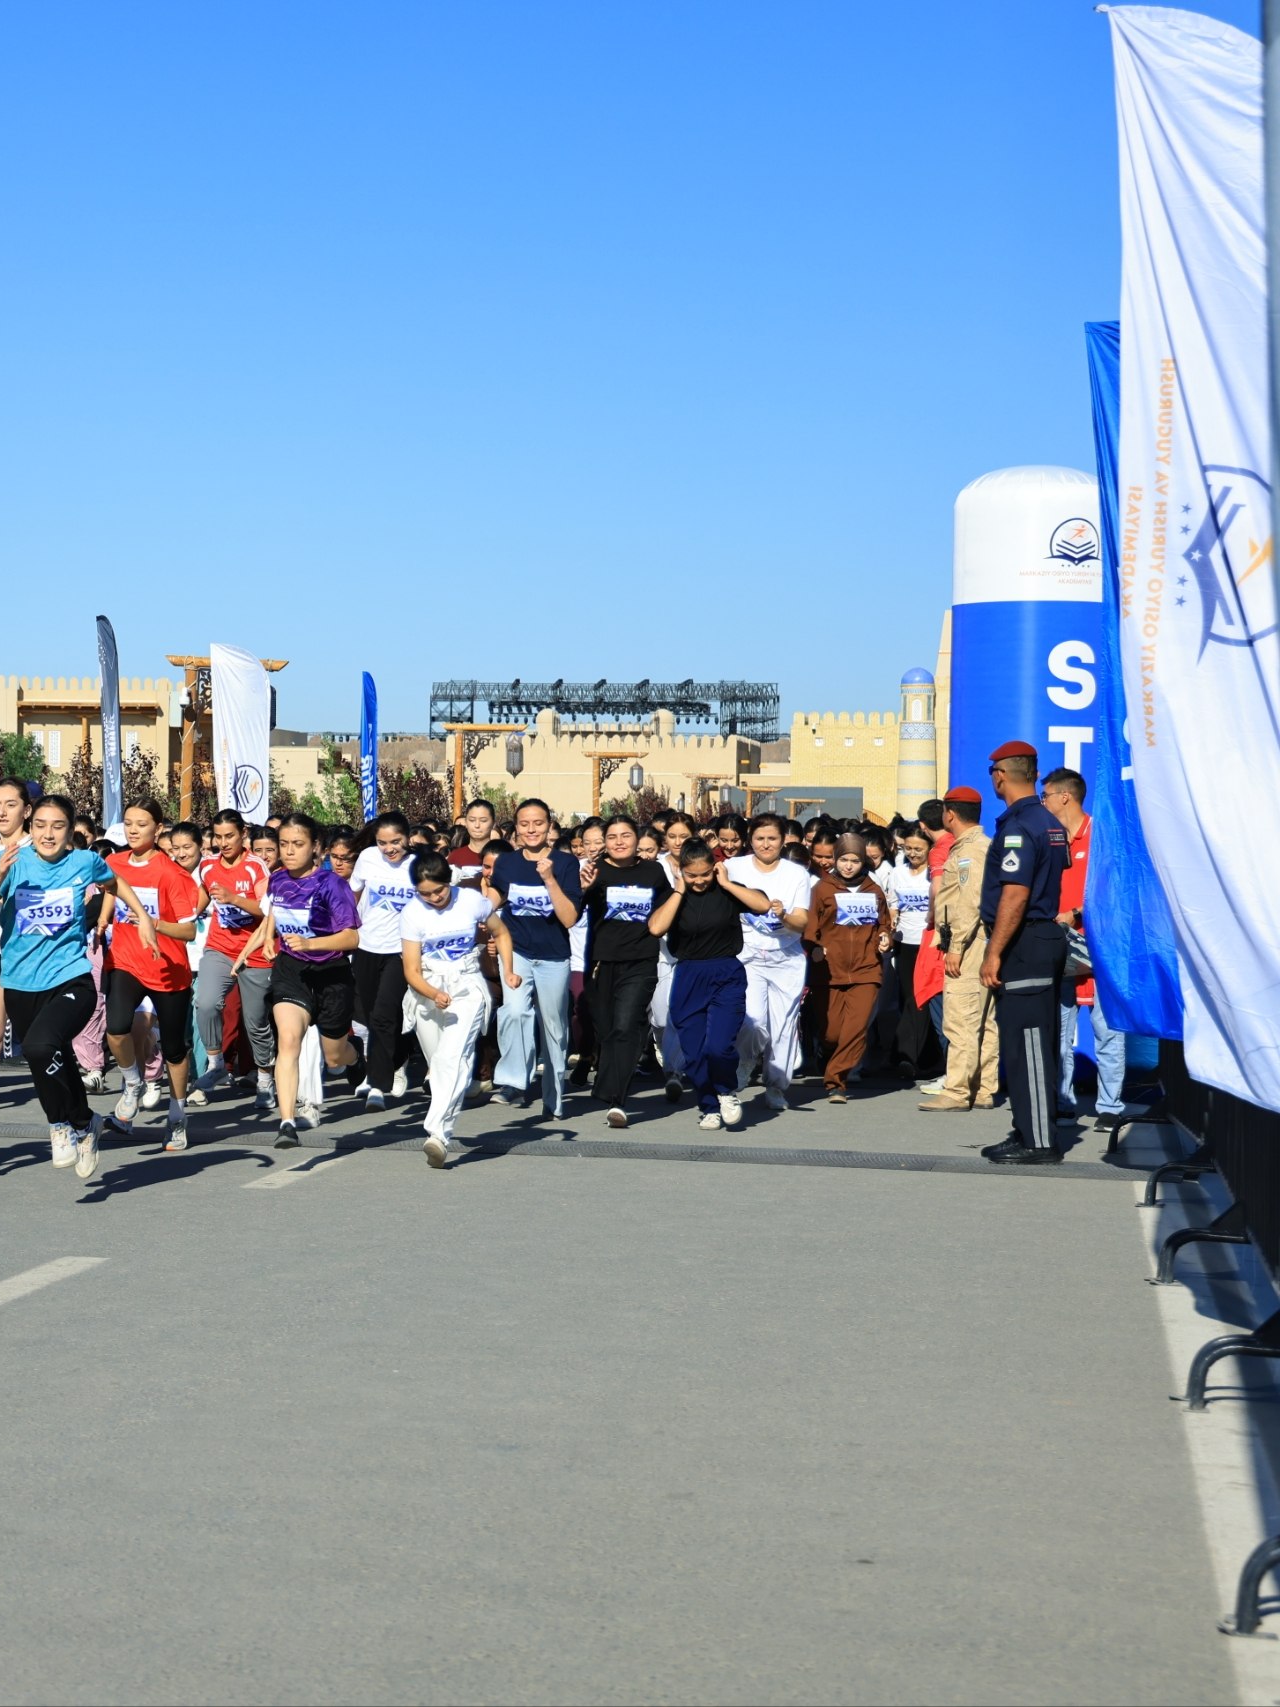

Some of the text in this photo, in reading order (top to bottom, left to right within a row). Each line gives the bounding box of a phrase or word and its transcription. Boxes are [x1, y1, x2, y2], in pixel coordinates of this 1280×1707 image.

[378, 885, 414, 899] 8445
[517, 896, 551, 907] 8451
[28, 905, 72, 919] 33593
